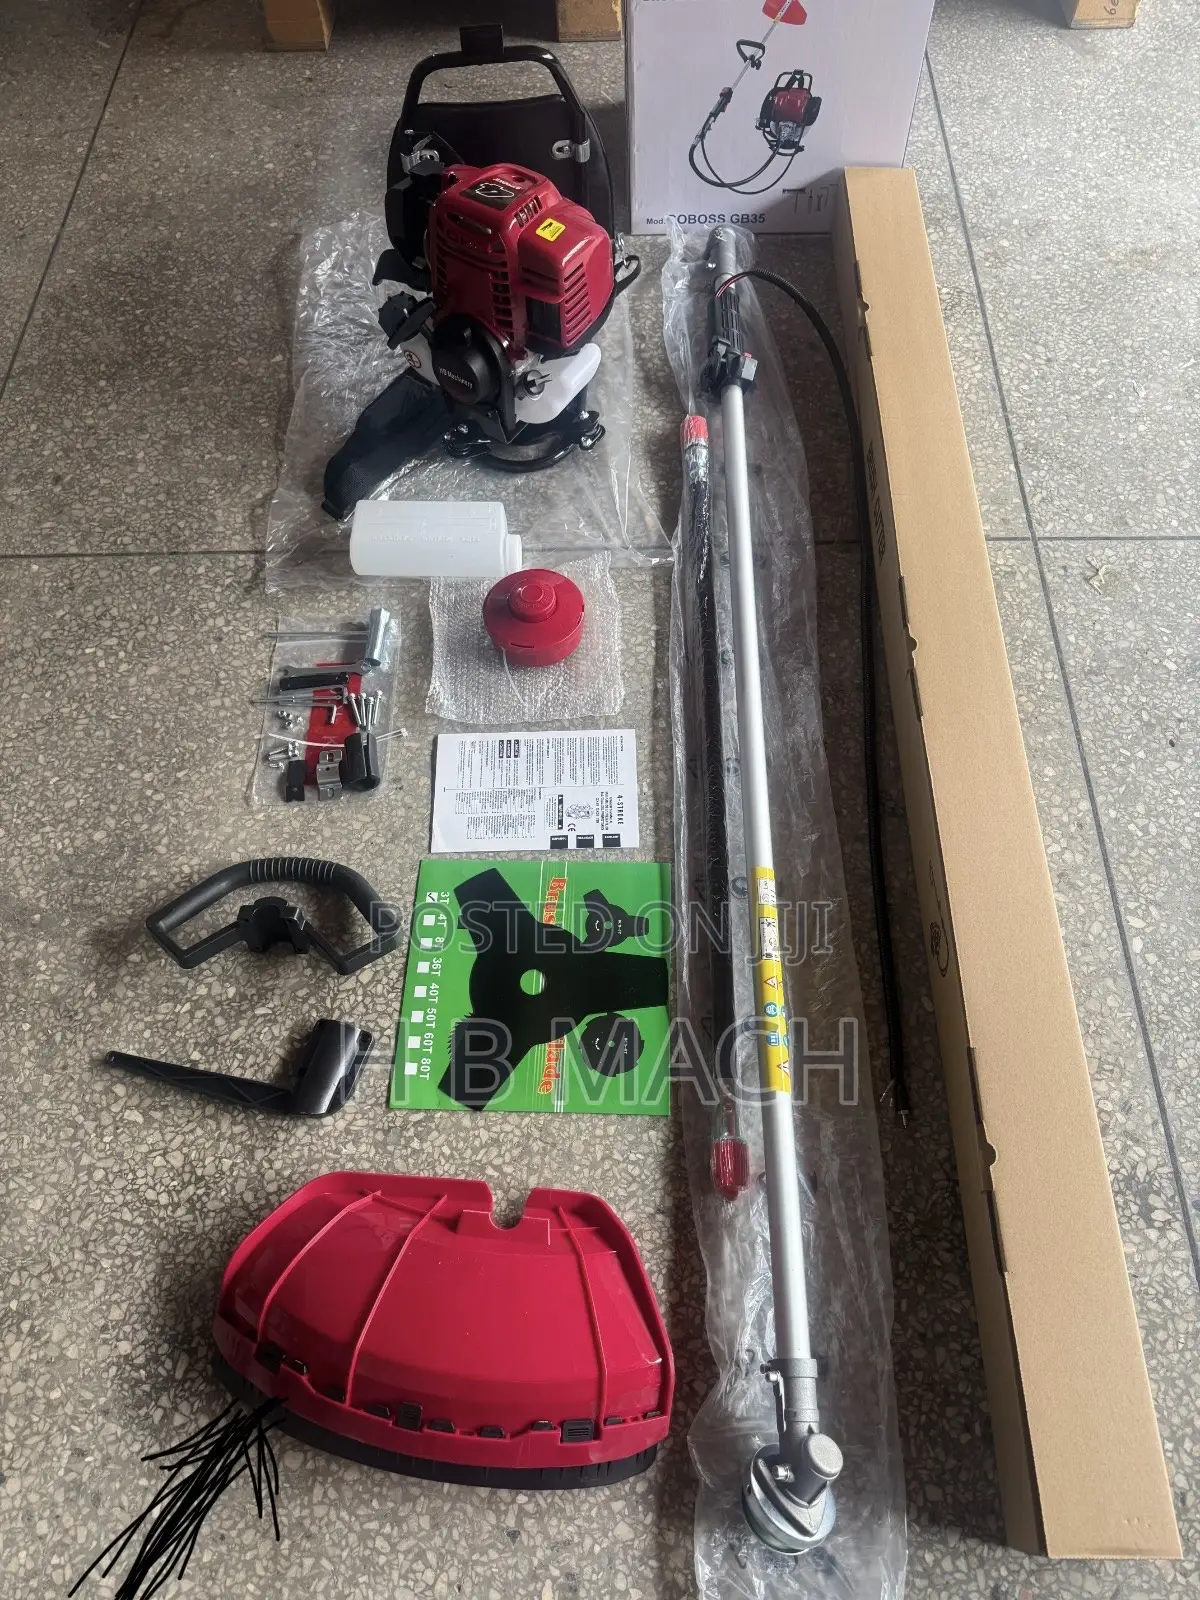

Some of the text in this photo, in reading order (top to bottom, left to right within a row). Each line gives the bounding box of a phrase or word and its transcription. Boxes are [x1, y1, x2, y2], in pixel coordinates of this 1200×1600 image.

[730, 213, 766, 224] GB35
[419, 891, 450, 1081] 3T 4T 8T 36T 40T 50T 60T 80T
[537, 877, 568, 1095] Brus lade
